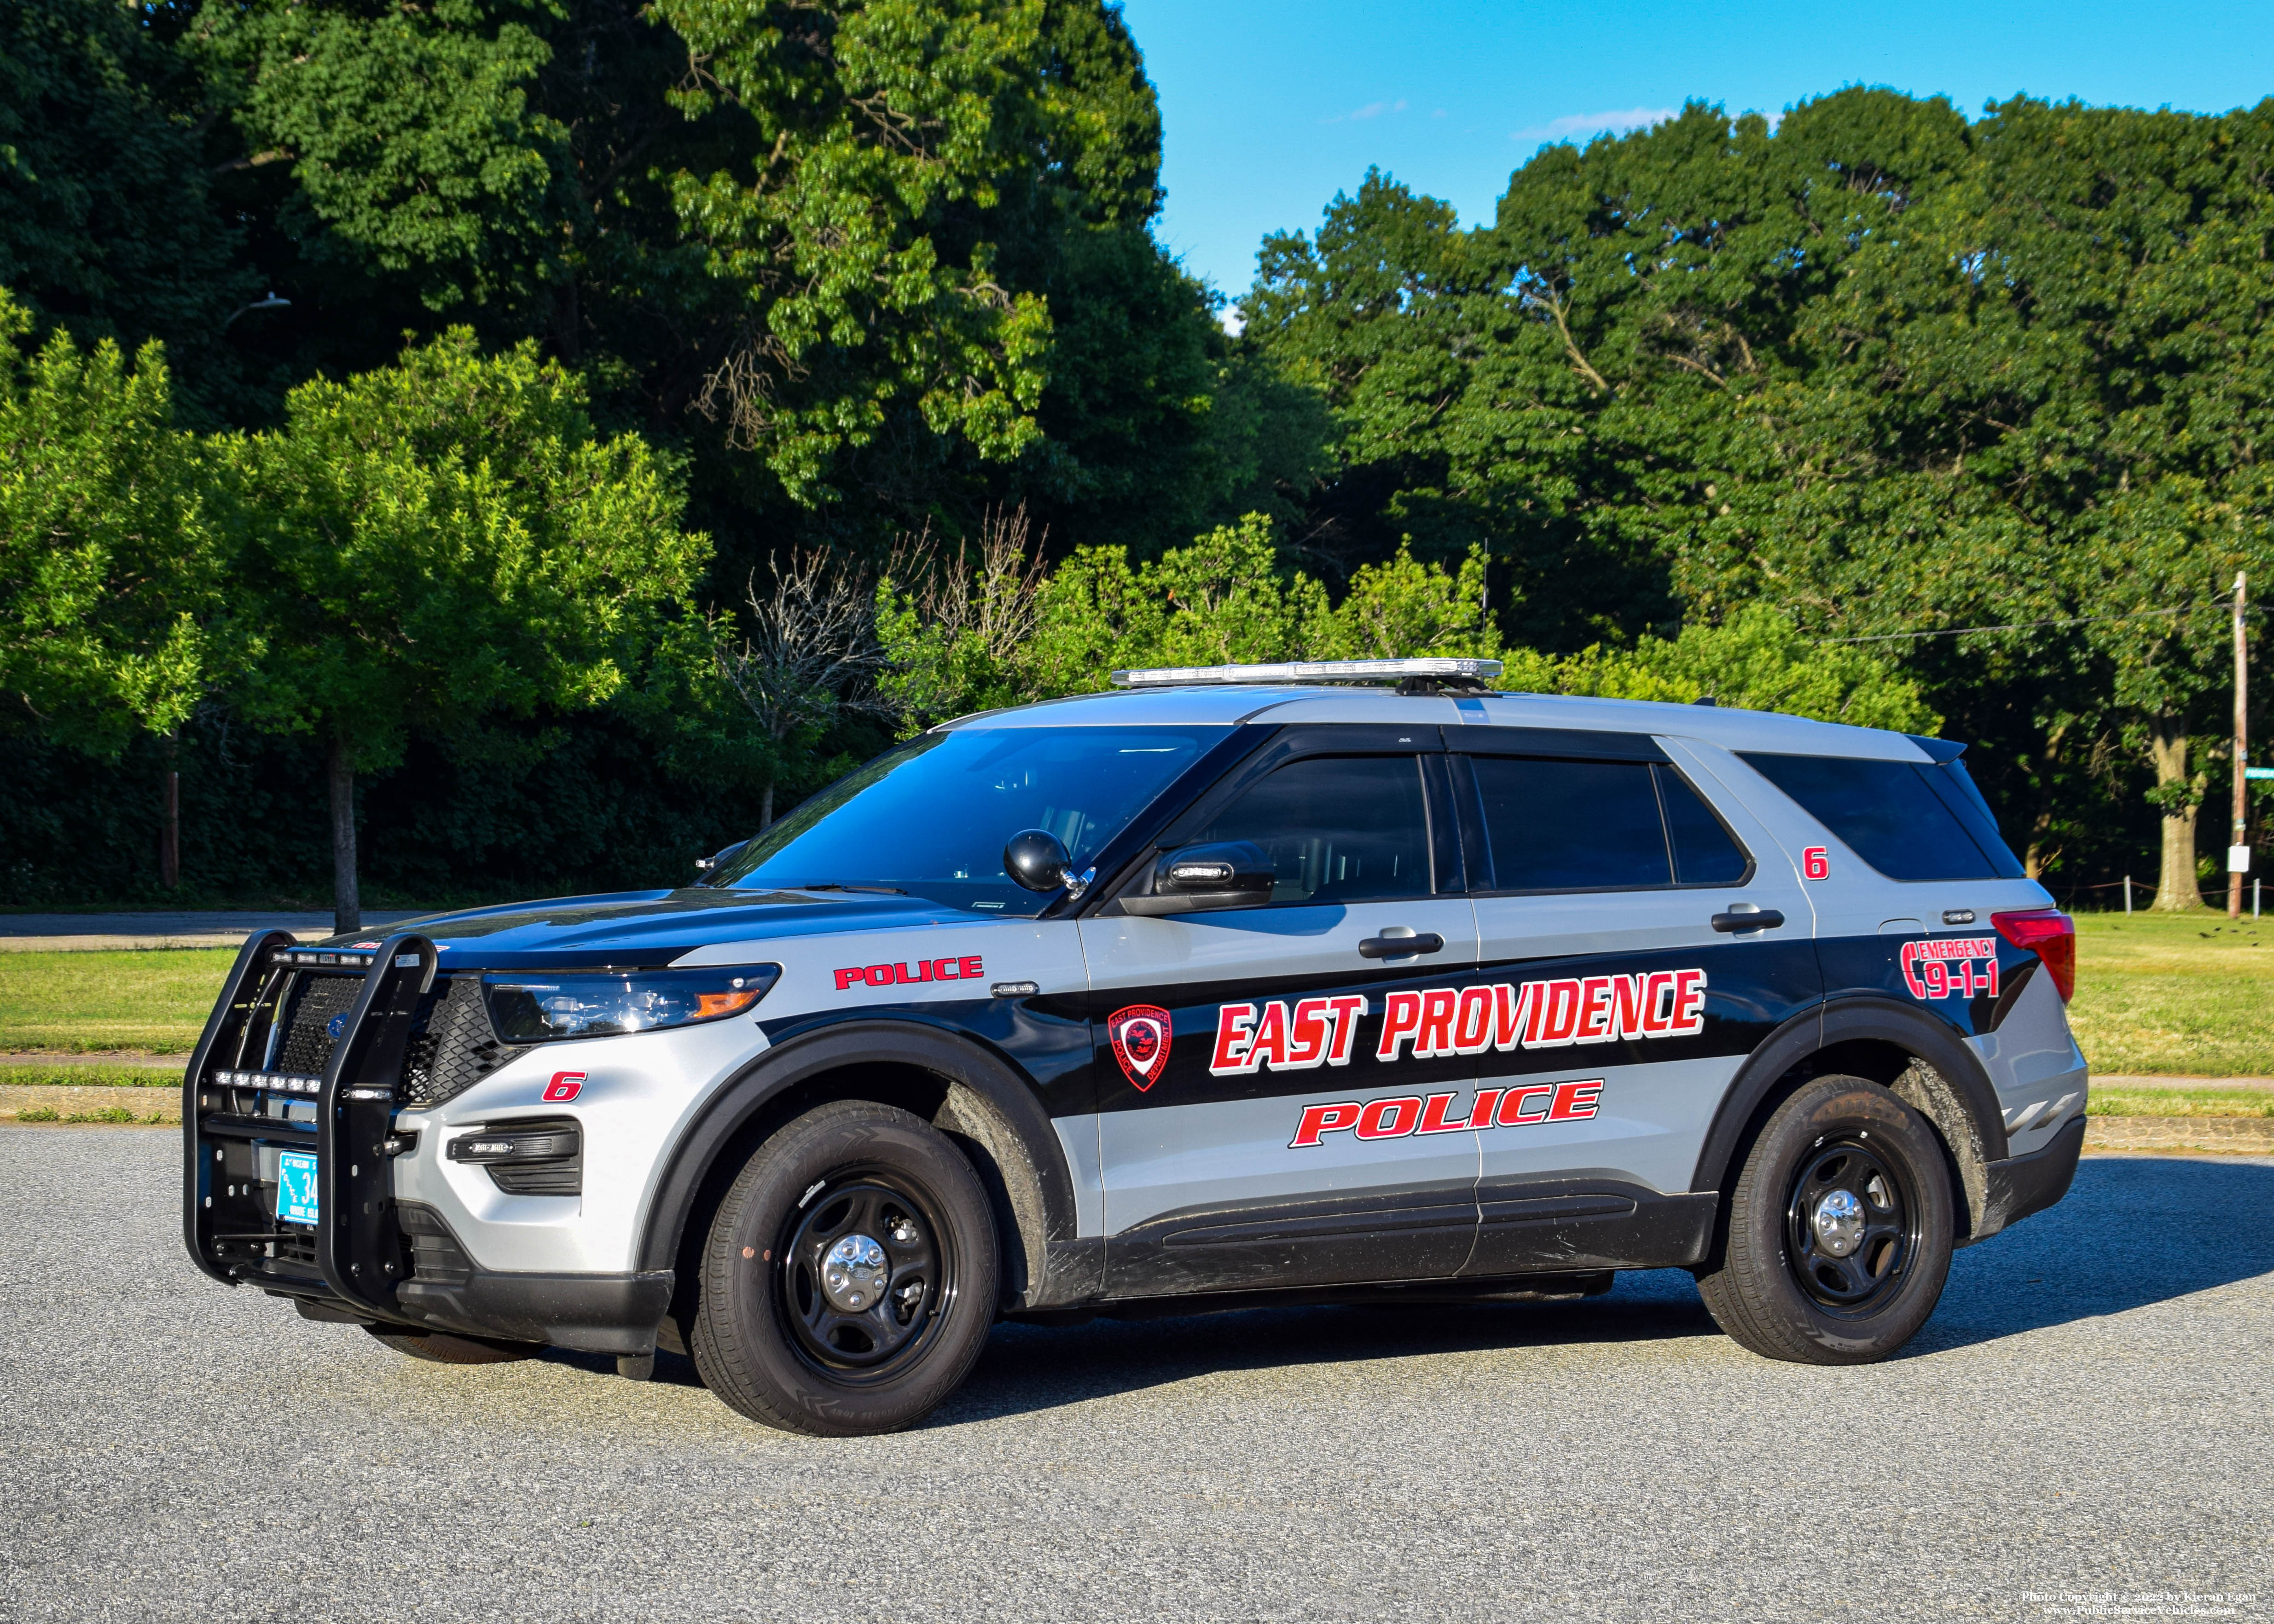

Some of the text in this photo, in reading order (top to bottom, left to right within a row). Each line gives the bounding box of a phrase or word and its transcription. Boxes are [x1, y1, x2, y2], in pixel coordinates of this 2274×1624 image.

[1803, 846, 1829, 881] 6
[1916, 937, 1996, 961] EMERGENCY
[833, 955, 984, 990] POLICE
[1923, 958, 1999, 999] 9-1-1
[1111, 1008, 1168, 1028] EAST PROVIDENCE
[1209, 969, 1707, 1076] EAST PROVIDENCE
[1114, 1039, 1134, 1073] POLICE
[1147, 1026, 1169, 1080] DEPARTMENT
[541, 1071, 588, 1103] 6
[1287, 1078, 1605, 1149] POLICE
